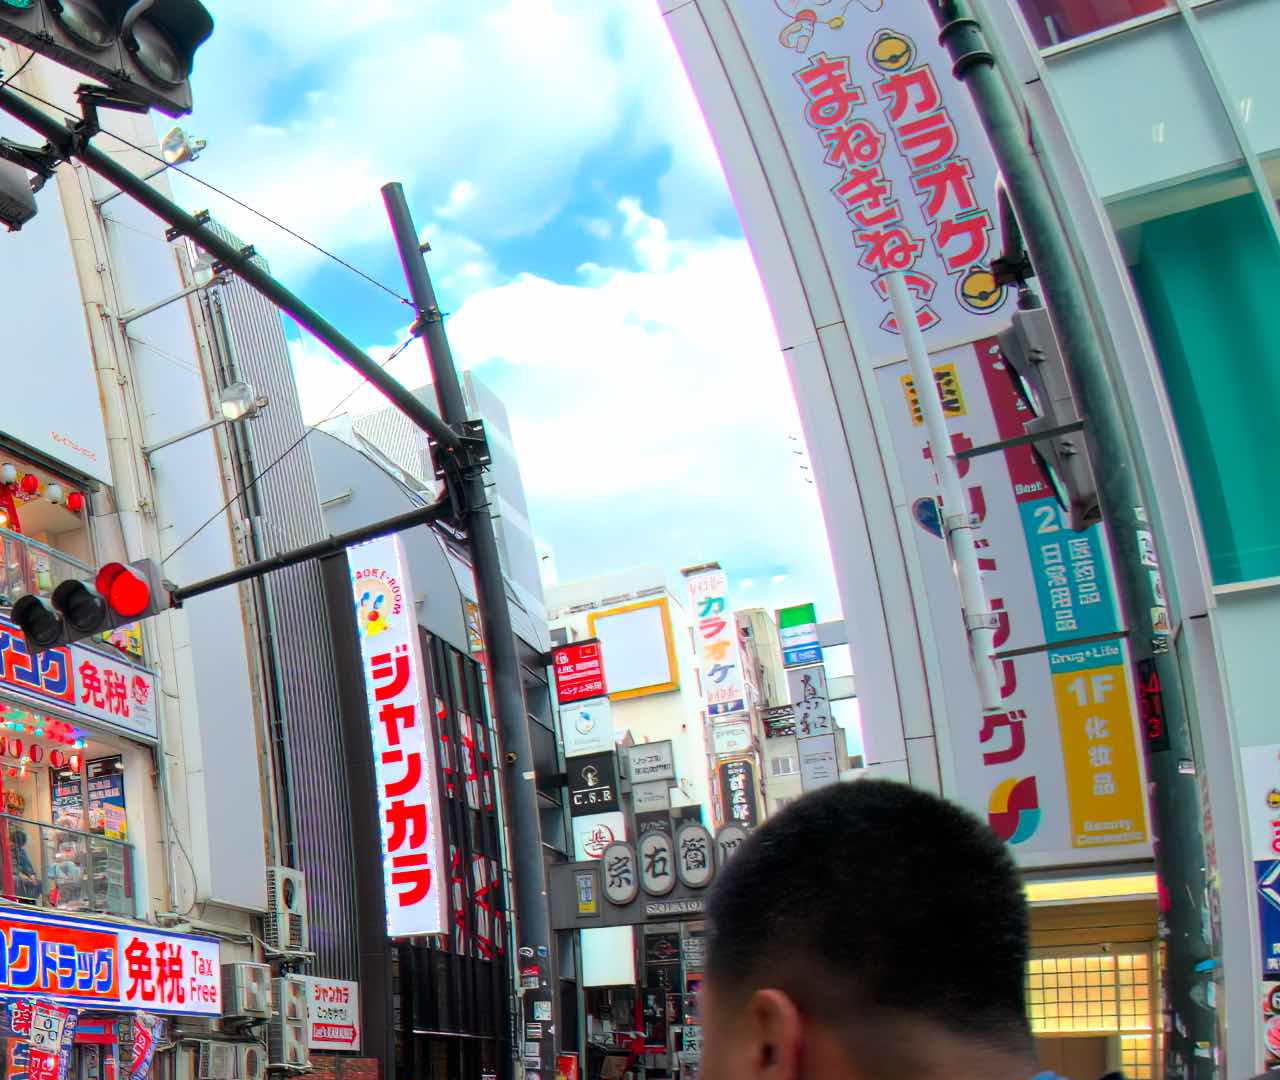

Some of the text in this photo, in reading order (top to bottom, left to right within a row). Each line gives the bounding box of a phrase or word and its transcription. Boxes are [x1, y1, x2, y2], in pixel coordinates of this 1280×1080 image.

[878, 68, 989, 271] カラオケ
[696, 596, 737, 685] カラオケ
[78, 660, 130, 718] 免税
[1067, 675, 1115, 706] 1F
[370, 644, 431, 907] ジャンカラ
[124, 937, 186, 1004] 免税
[190, 977, 217, 1003] Free
[191, 950, 213, 977] Tax
